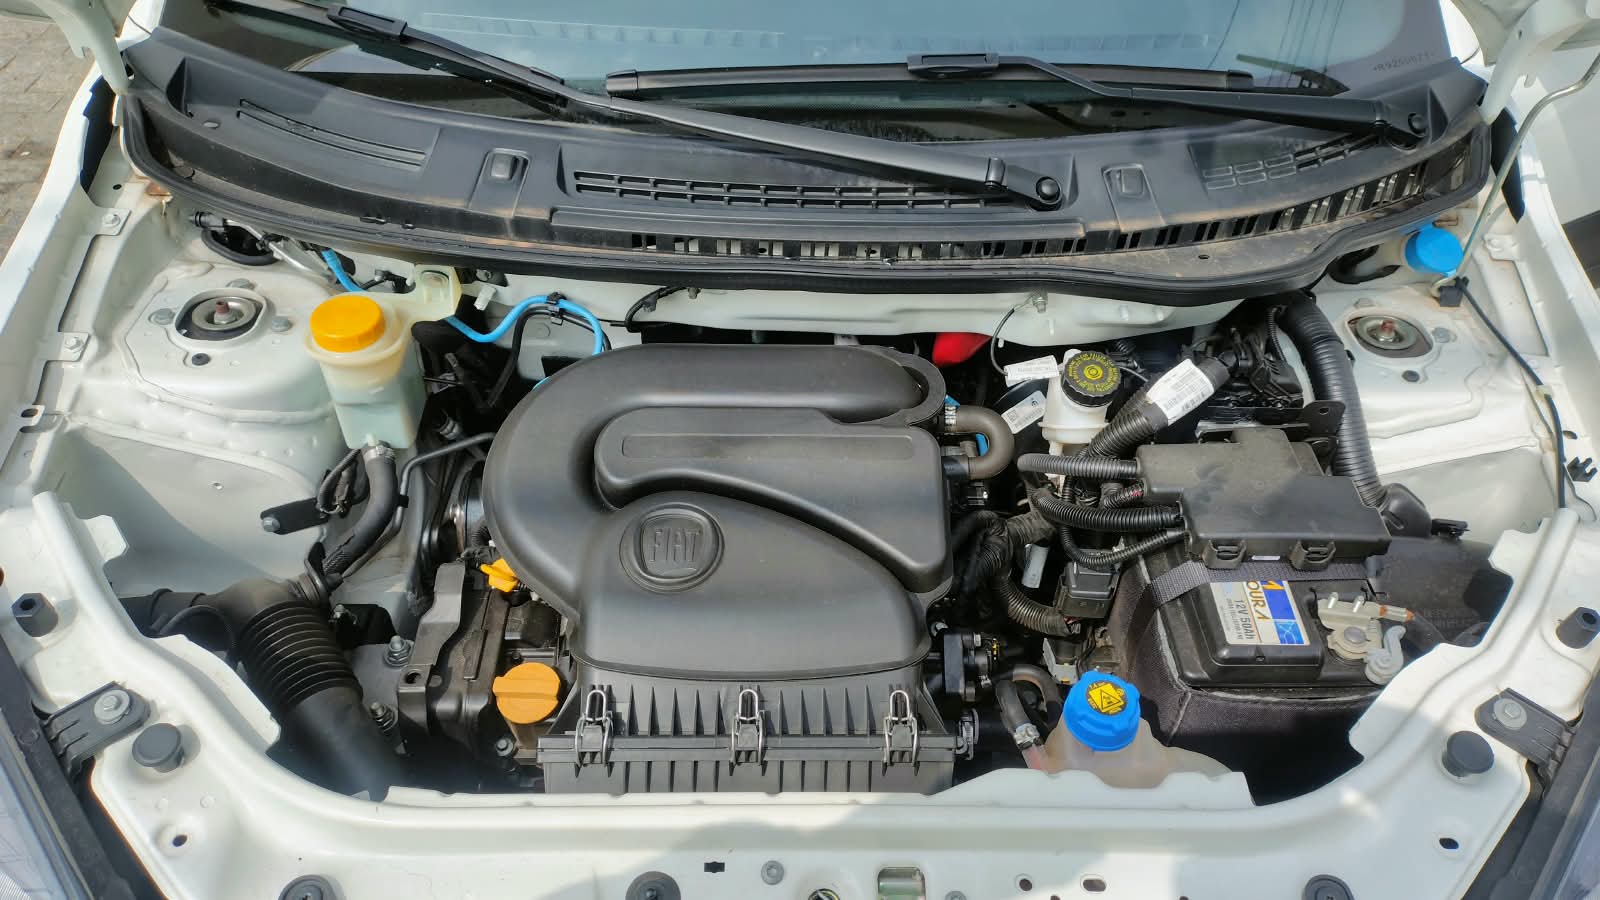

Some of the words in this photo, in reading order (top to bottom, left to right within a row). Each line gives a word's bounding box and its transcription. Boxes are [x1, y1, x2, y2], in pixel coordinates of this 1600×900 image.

[648, 527, 701, 562] FIAT
[1235, 599, 1248, 615] 12V
[1246, 580, 1271, 620] OURA
[1241, 617, 1256, 640] 50Ah
